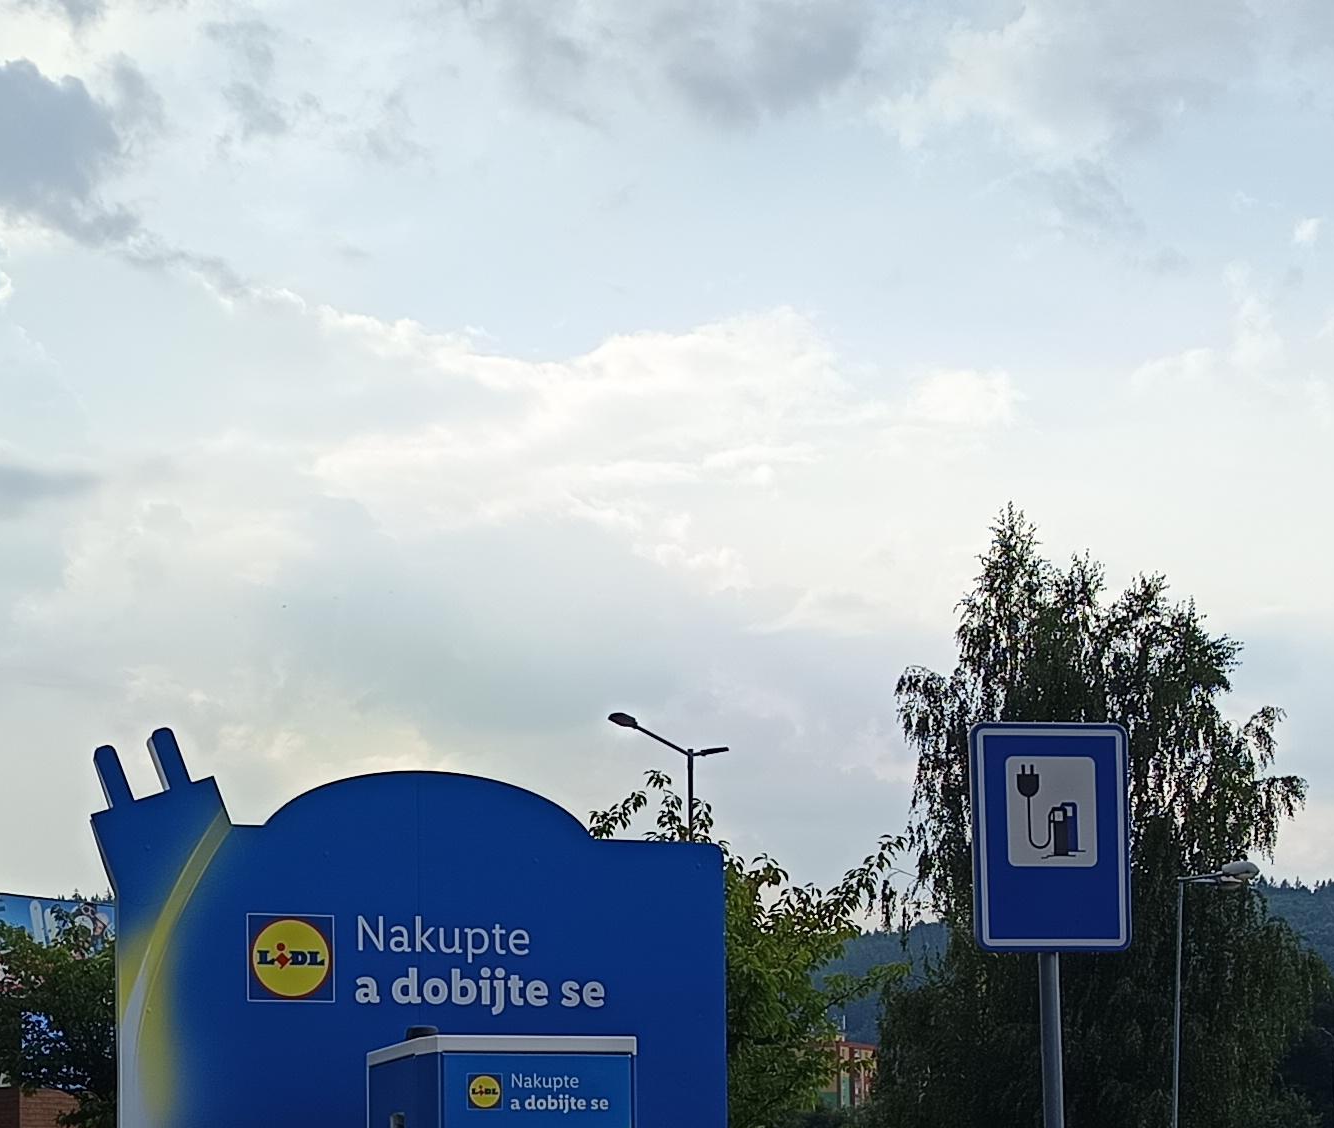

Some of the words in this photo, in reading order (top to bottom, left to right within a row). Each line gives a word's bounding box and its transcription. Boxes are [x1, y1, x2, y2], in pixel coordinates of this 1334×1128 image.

[357, 915, 530, 963] Nakupte
[355, 977, 380, 1004] a
[391, 967, 549, 1016] dobijte
[560, 979, 605, 1008] se
[510, 1072, 580, 1092] Nakupte
[510, 1098, 521, 1110] a
[524, 1094, 587, 1114] dobijte
[590, 1098, 609, 1111] se
